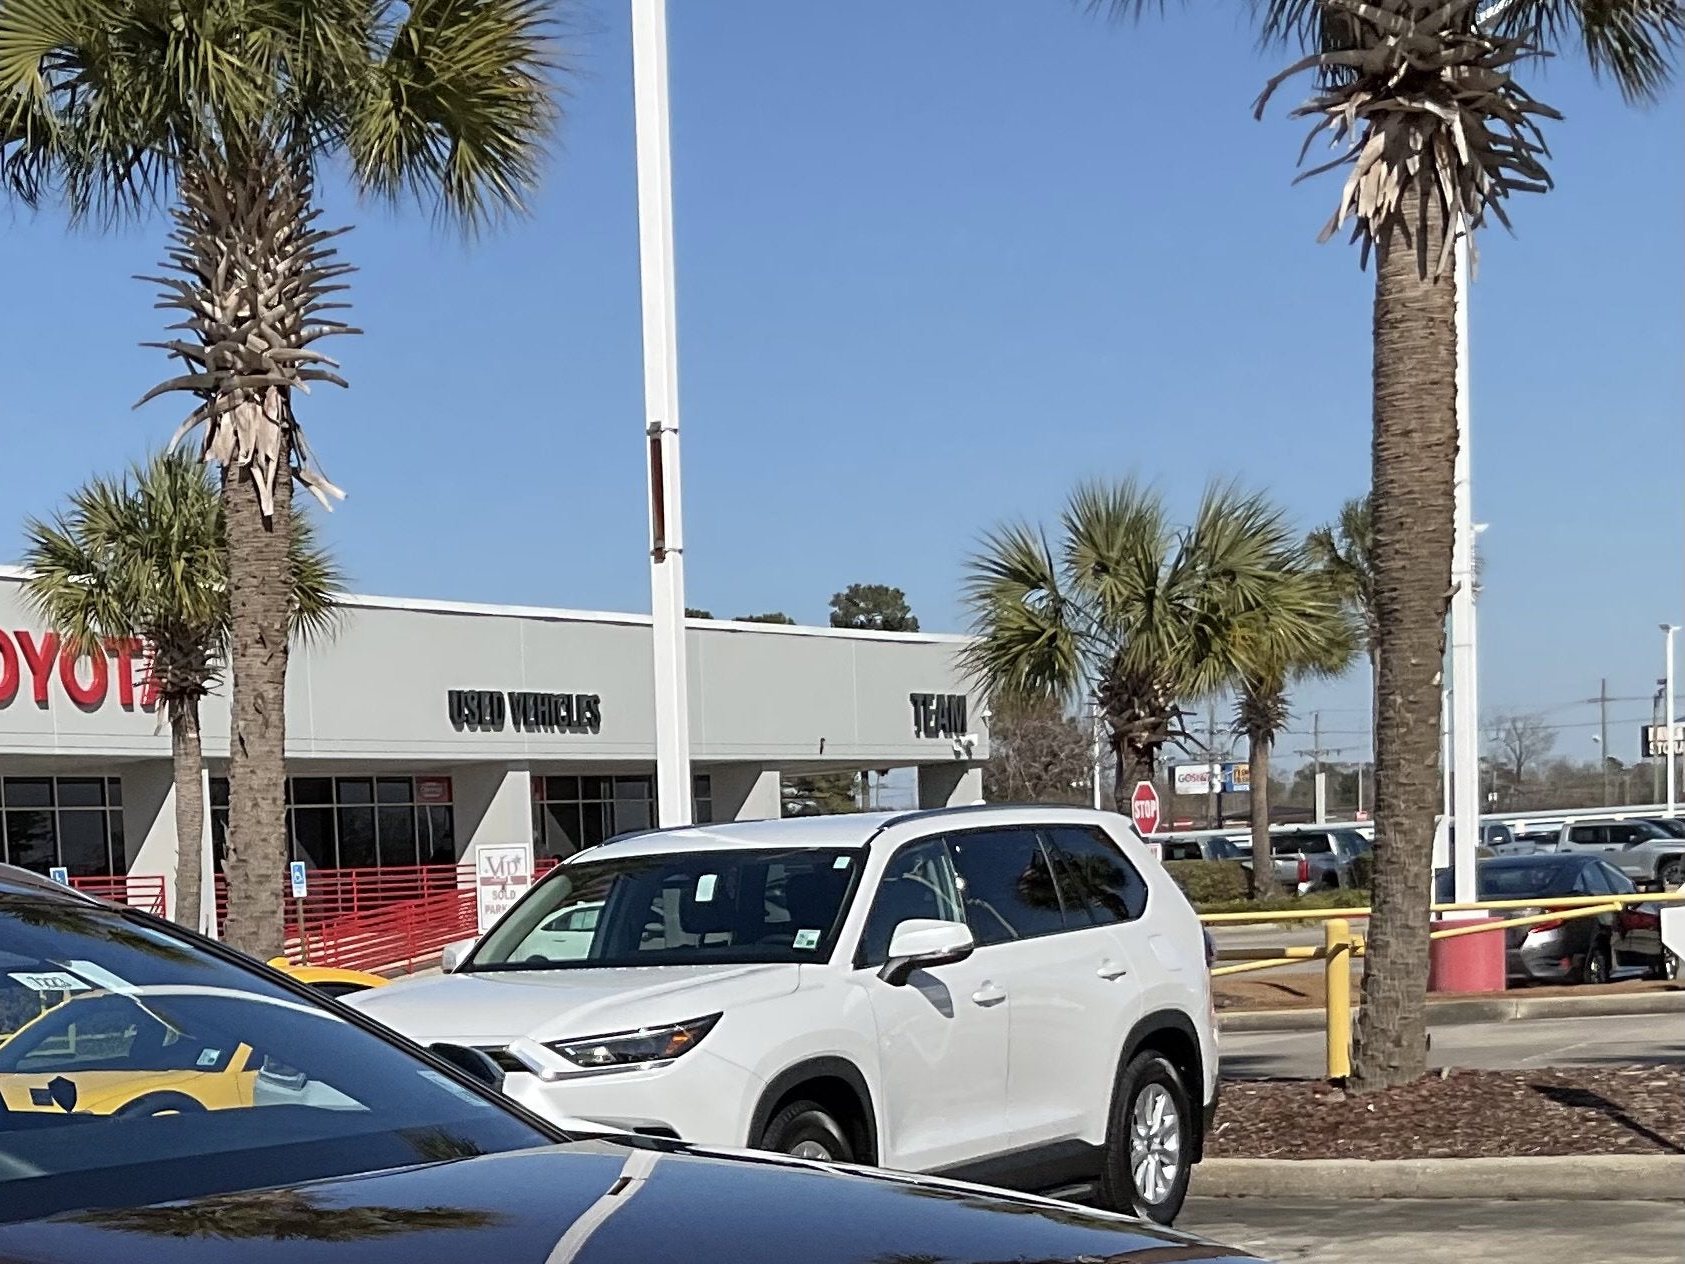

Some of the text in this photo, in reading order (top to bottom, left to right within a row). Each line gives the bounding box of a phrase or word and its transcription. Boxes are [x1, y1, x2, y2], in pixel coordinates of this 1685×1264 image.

[448, 690, 601, 734] USED VEHICLES
[910, 693, 967, 738] TEAM
[1134, 799, 1156, 819] STOP
[492, 889, 516, 901] SOLD
